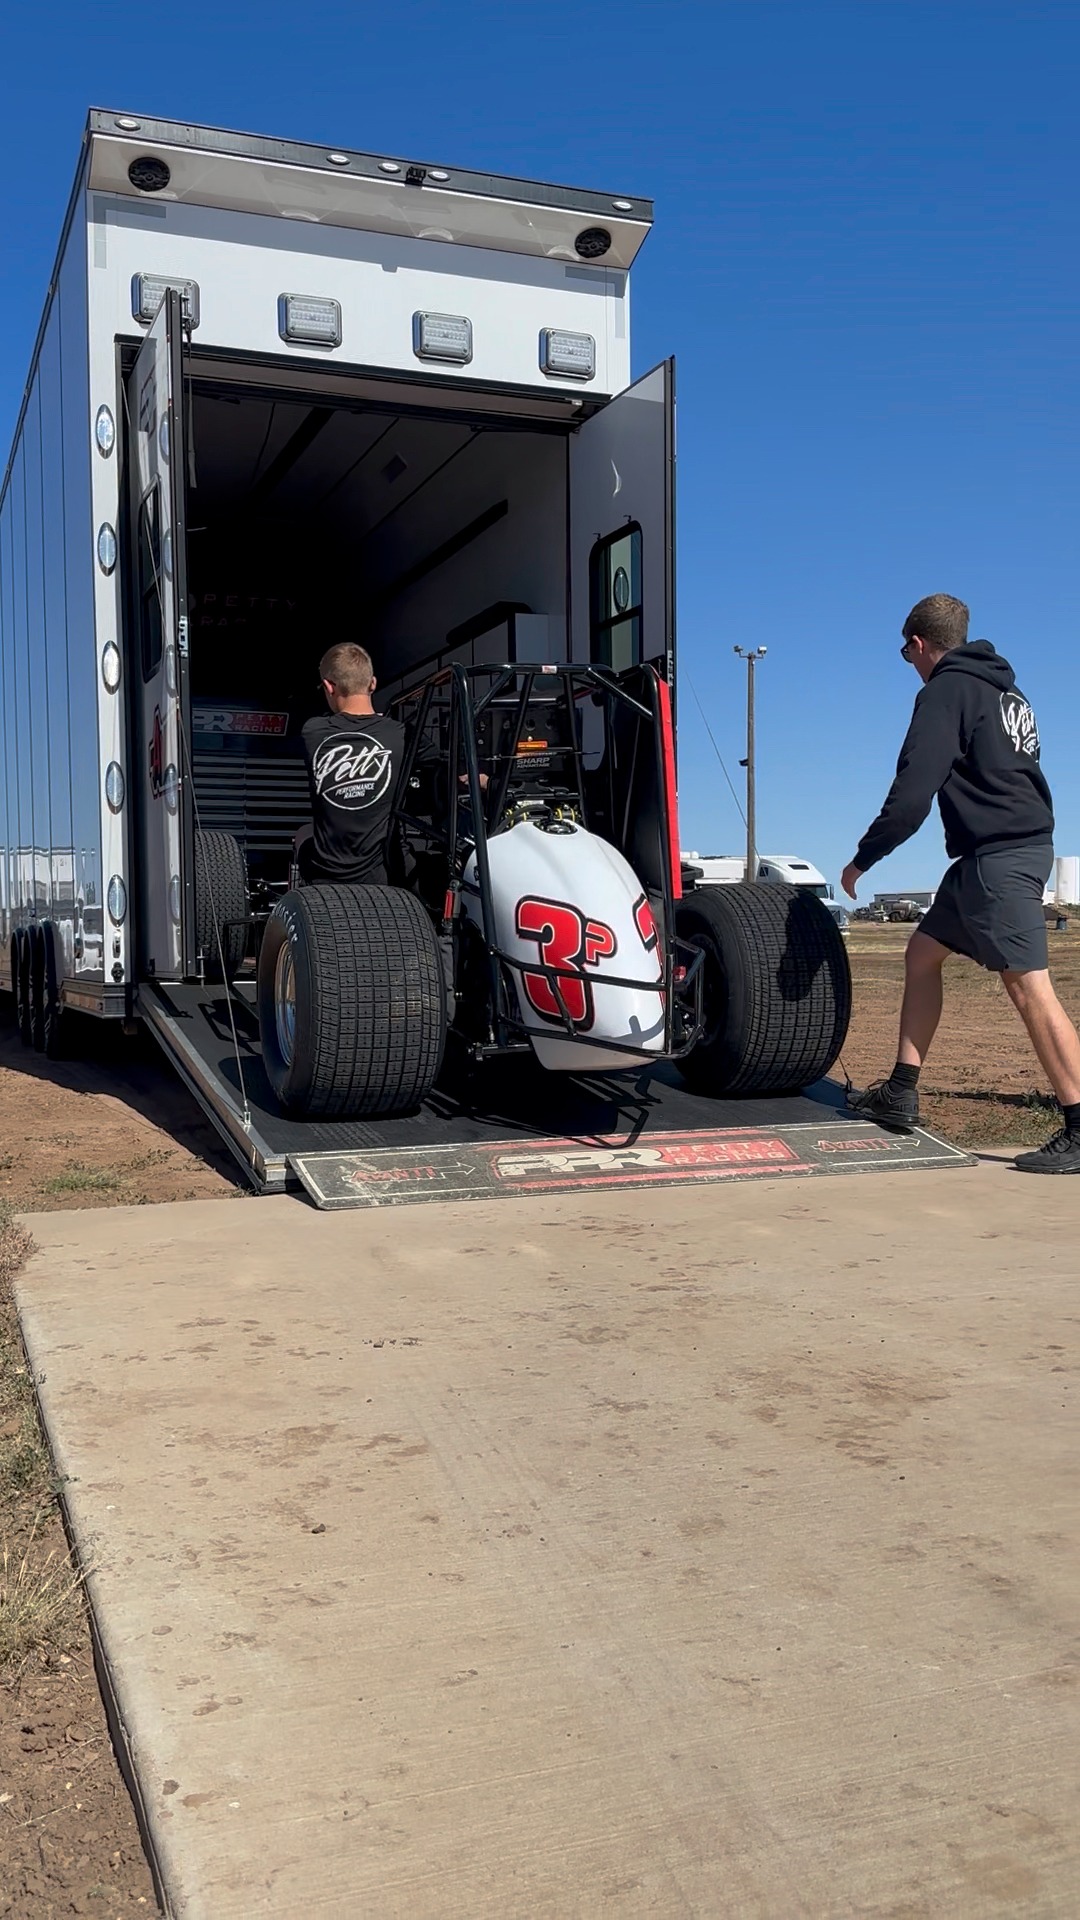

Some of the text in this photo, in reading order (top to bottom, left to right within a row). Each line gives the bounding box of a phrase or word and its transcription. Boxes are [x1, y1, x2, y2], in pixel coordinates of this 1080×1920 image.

[203, 594, 296, 609] PETTY
[236, 713, 284, 721] PETTY
[235, 724, 282, 732] RACING
[517, 757, 550, 765] SHARP
[316, 744, 392, 795] Petty
[335, 783, 375, 796] PERFORMANCE
[344, 790, 366, 799] RACING
[664, 1141, 775, 1154] PETTY
[818, 1138, 892, 1152] AVANTI
[674, 1152, 786, 1165] RACING
